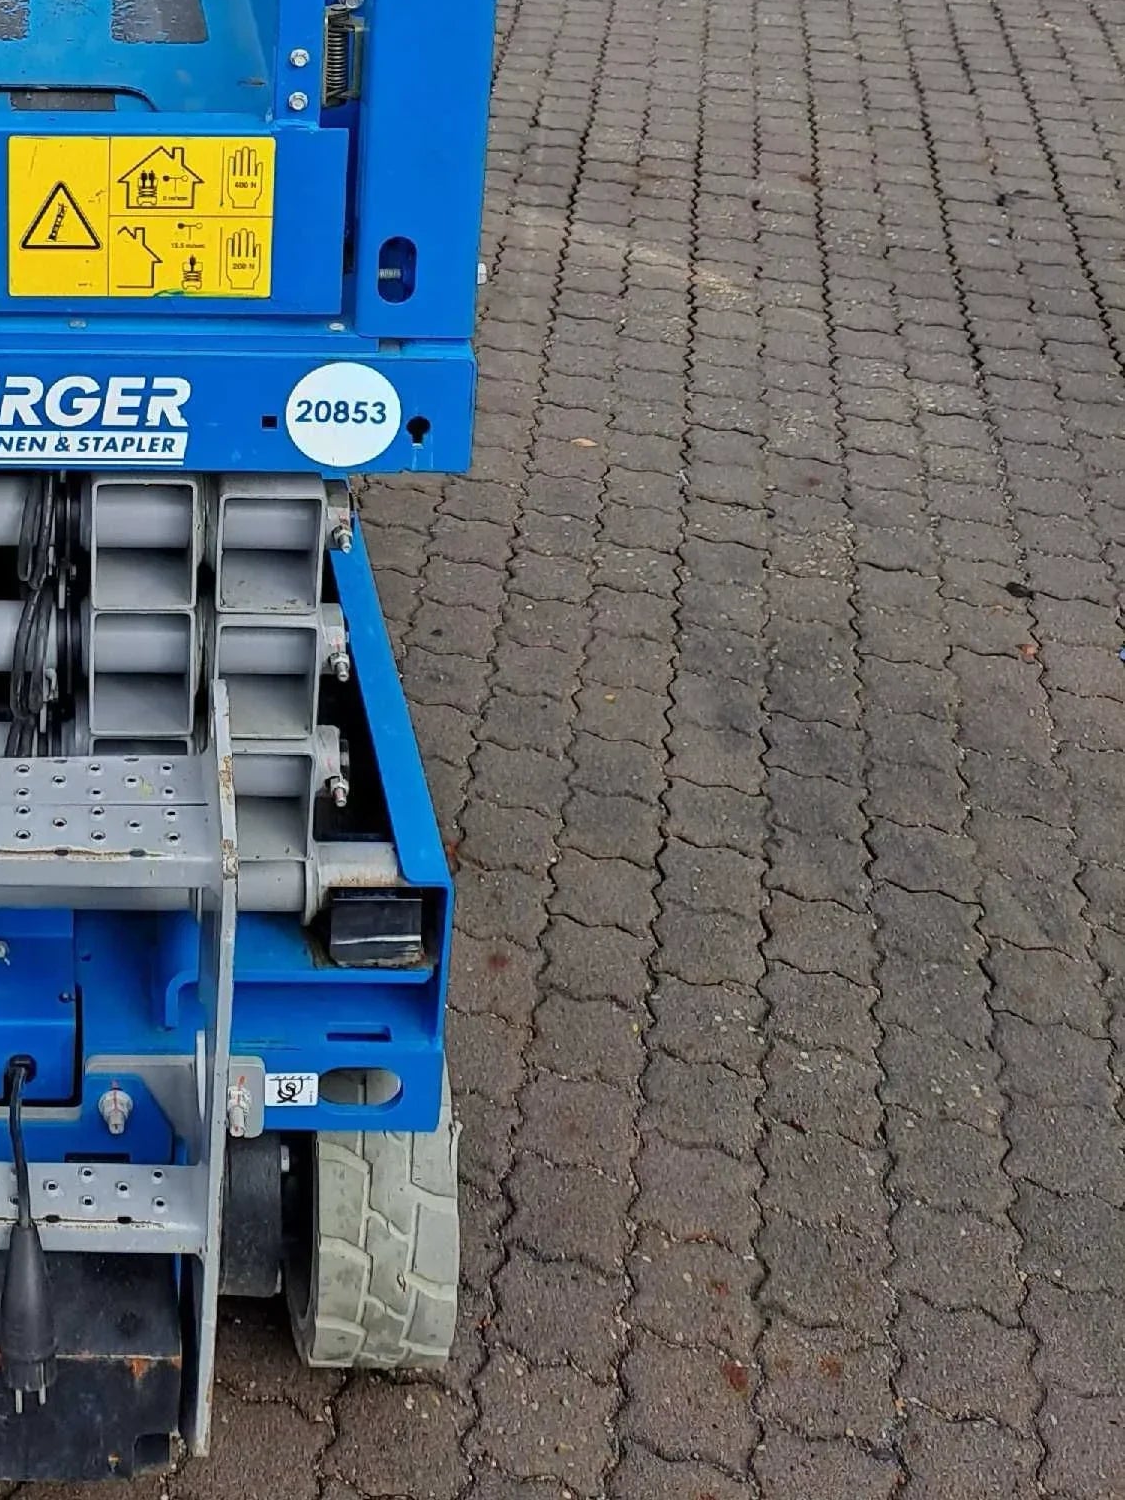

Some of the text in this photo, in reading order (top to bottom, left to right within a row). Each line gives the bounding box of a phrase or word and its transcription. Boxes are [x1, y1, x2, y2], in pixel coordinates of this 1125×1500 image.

[295, 400, 386, 424] 20853
[54, 436, 71, 452] &
[77, 437, 176, 453] STAPLER
